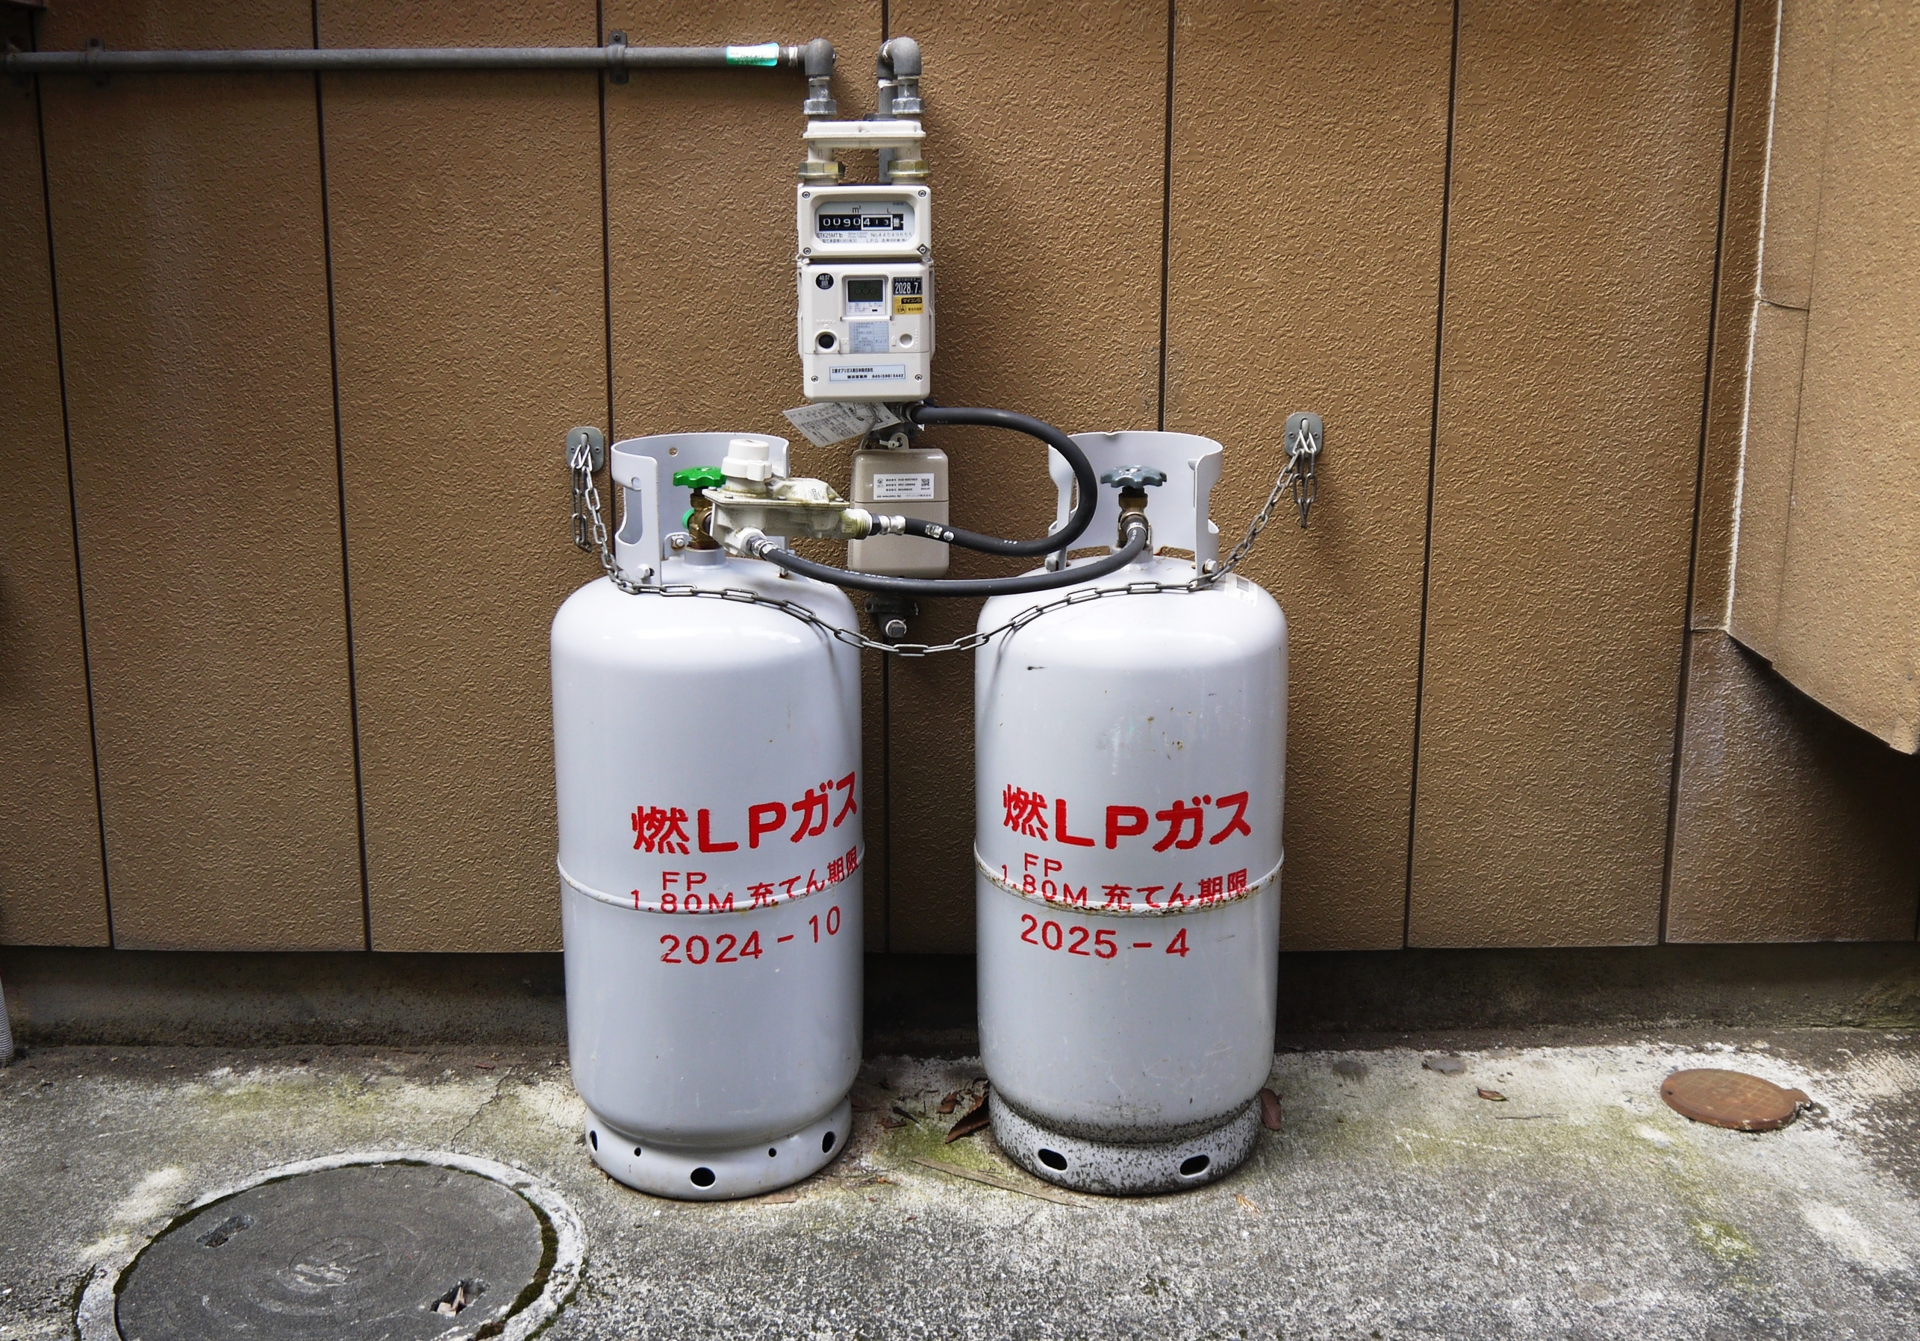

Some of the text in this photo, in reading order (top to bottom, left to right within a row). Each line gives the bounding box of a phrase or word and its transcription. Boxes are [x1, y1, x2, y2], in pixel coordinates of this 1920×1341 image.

[631, 771, 857, 855] 燃LPガス
[1002, 783, 1252, 853] 燃LPガス
[631, 845, 859, 914] 1.80M 充てん期限
[661, 871, 708, 892] FP
[1001, 864, 1250, 911] 1.80M 充てん期限
[1024, 852, 1063, 878] FP
